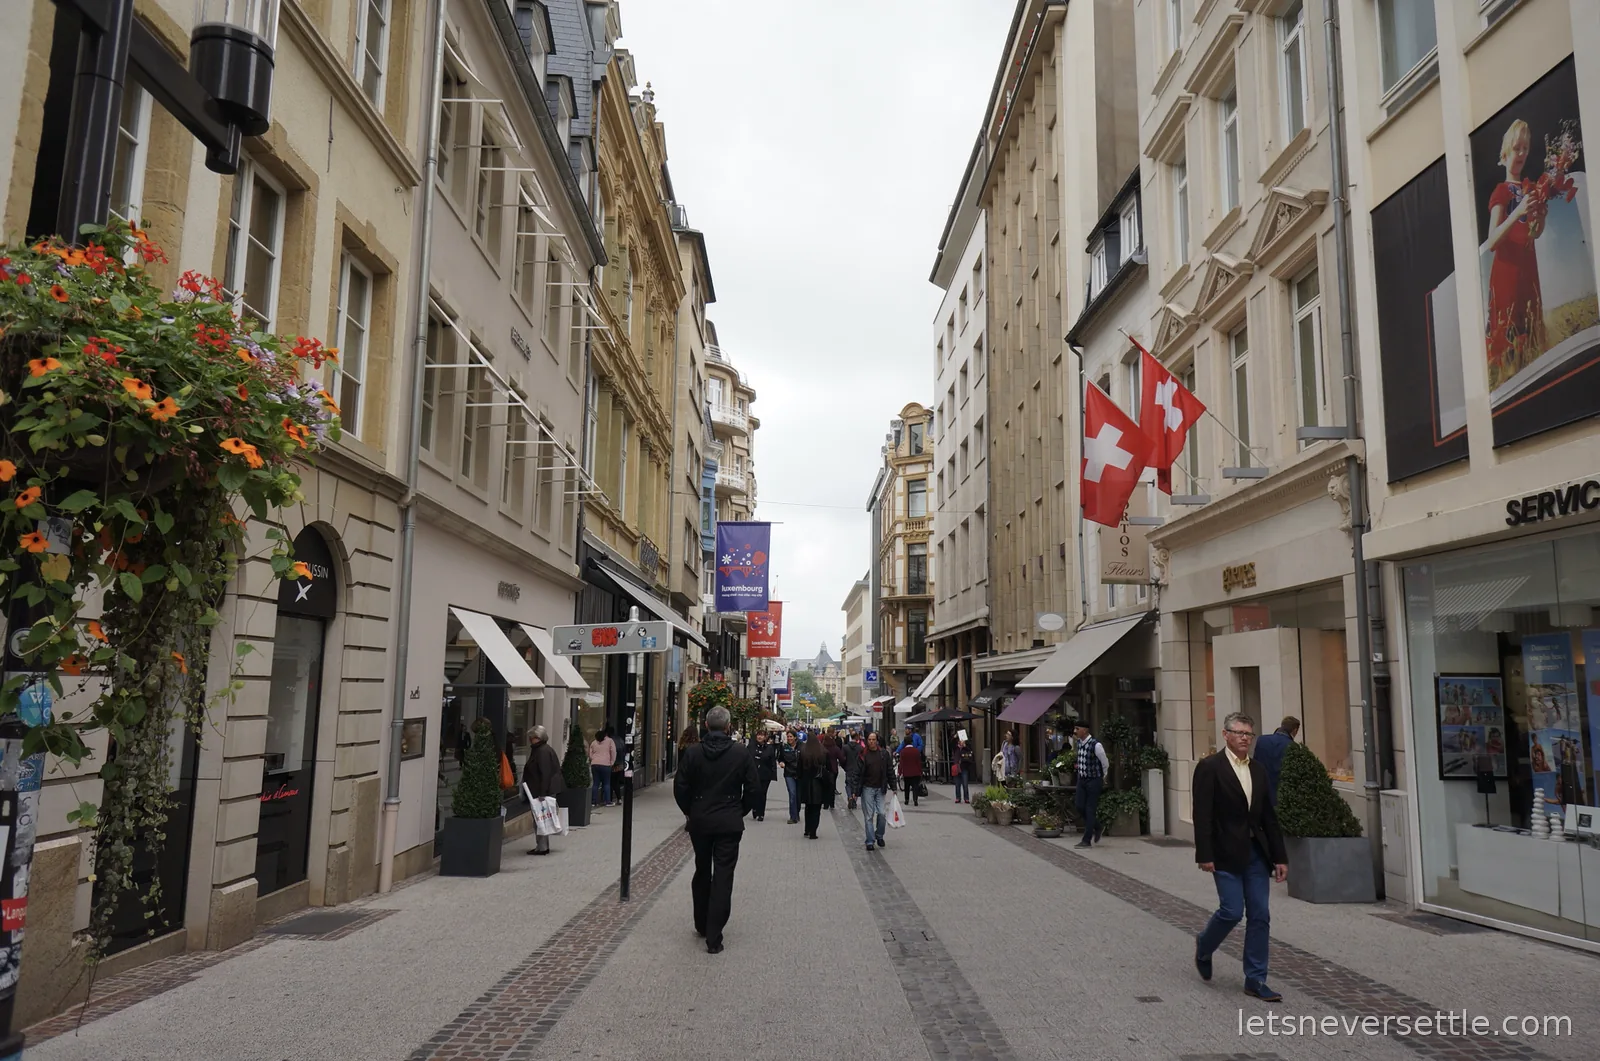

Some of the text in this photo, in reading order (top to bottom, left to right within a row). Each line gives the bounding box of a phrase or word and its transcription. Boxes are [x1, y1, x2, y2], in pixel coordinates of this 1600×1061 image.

[1505, 480, 1600, 526] SERVIC
[1104, 561, 1145, 576] Fleurs
[721, 584, 763, 594] luxembourg
